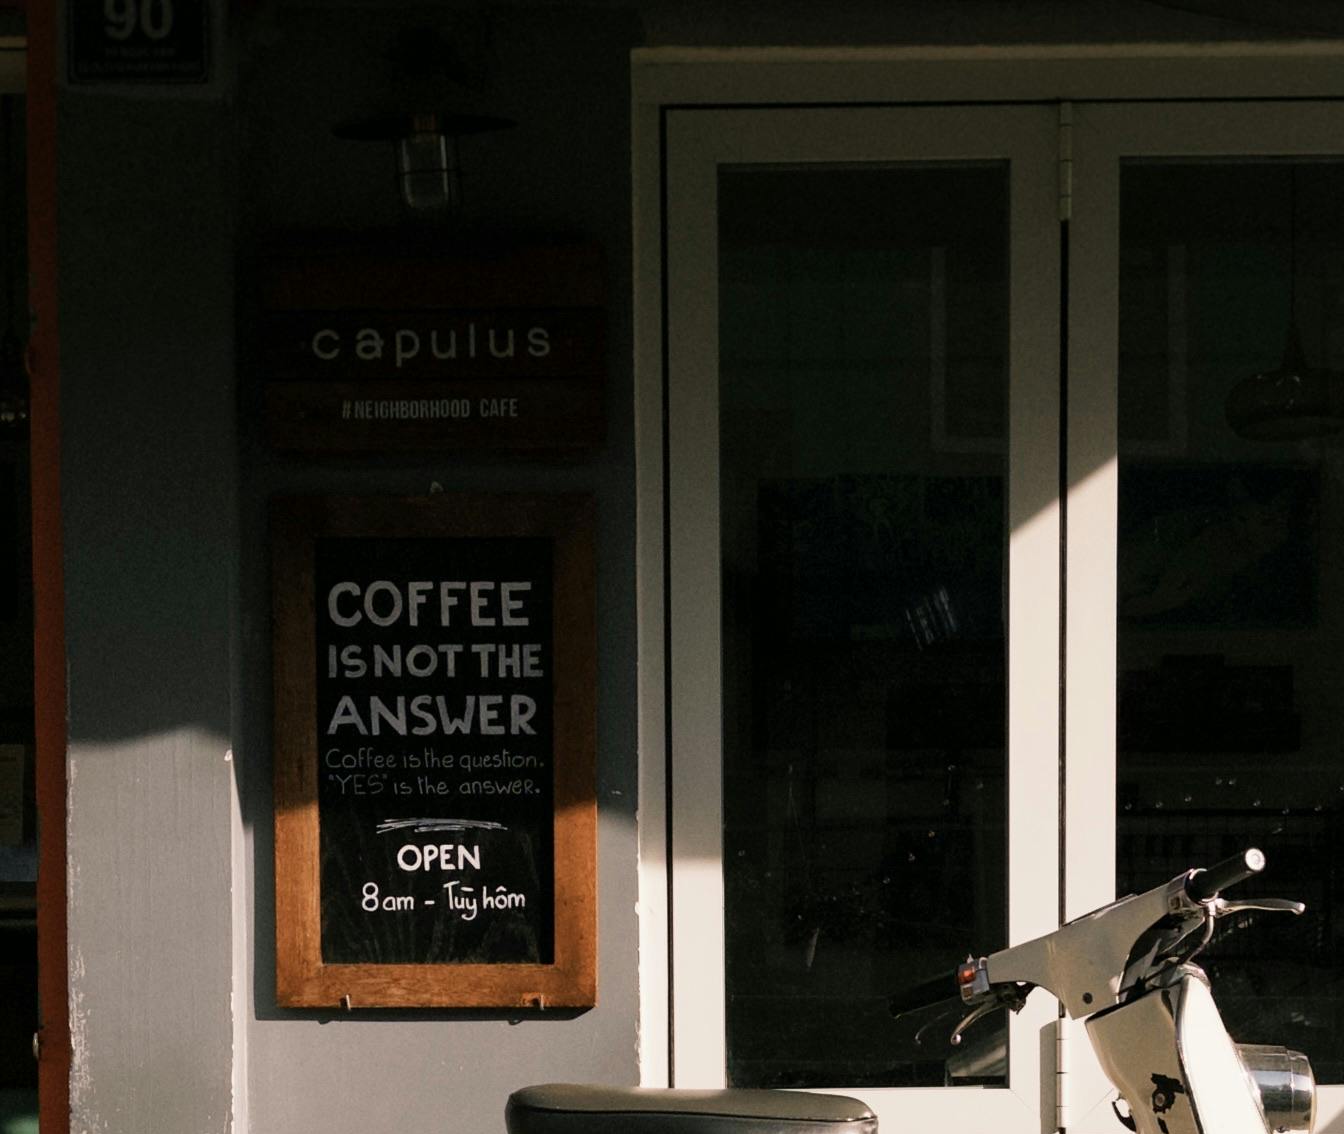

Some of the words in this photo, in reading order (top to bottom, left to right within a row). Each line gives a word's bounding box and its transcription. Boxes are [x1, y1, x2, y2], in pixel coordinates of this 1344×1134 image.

[104, 0, 175, 40] 90
[311, 322, 551, 368] capulus
[342, 399, 471, 420] #NEIGHBORHOOD
[479, 398, 519, 418] CAFE
[327, 580, 533, 628] COFFEE
[471, 643, 544, 679] THE
[326, 694, 538, 737] ANSWER
[325, 748, 398, 769] Coffee
[402, 752, 421, 769] is
[424, 747, 455, 769] the
[459, 748, 545, 772] question.
[393, 780, 413, 795] is
[417, 777, 449, 795] the
[396, 844, 481, 871] OPEN
[483, 885, 526, 911] hôm
